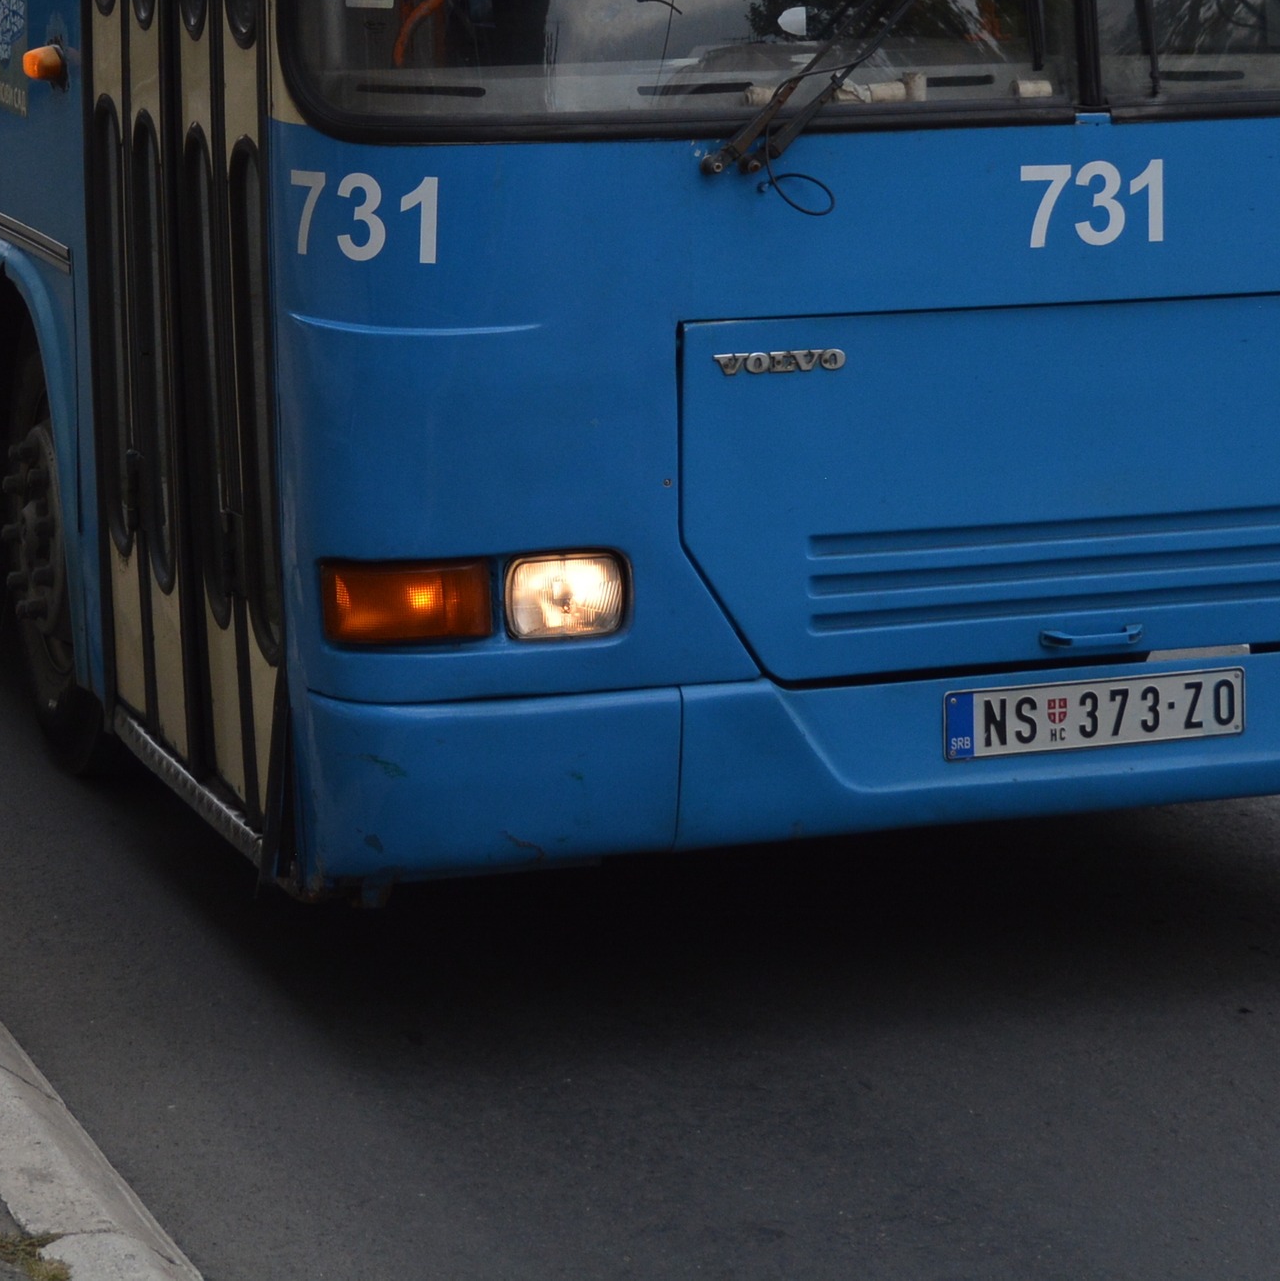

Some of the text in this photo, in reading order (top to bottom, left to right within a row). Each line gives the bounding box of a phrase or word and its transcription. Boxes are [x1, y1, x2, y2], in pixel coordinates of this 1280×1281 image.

[290, 170, 438, 264] 731
[1021, 159, 1165, 249] 731
[713, 348, 846, 375] VOLVO
[950, 737, 971, 749] SRB
[984, 697, 1037, 747] NS
